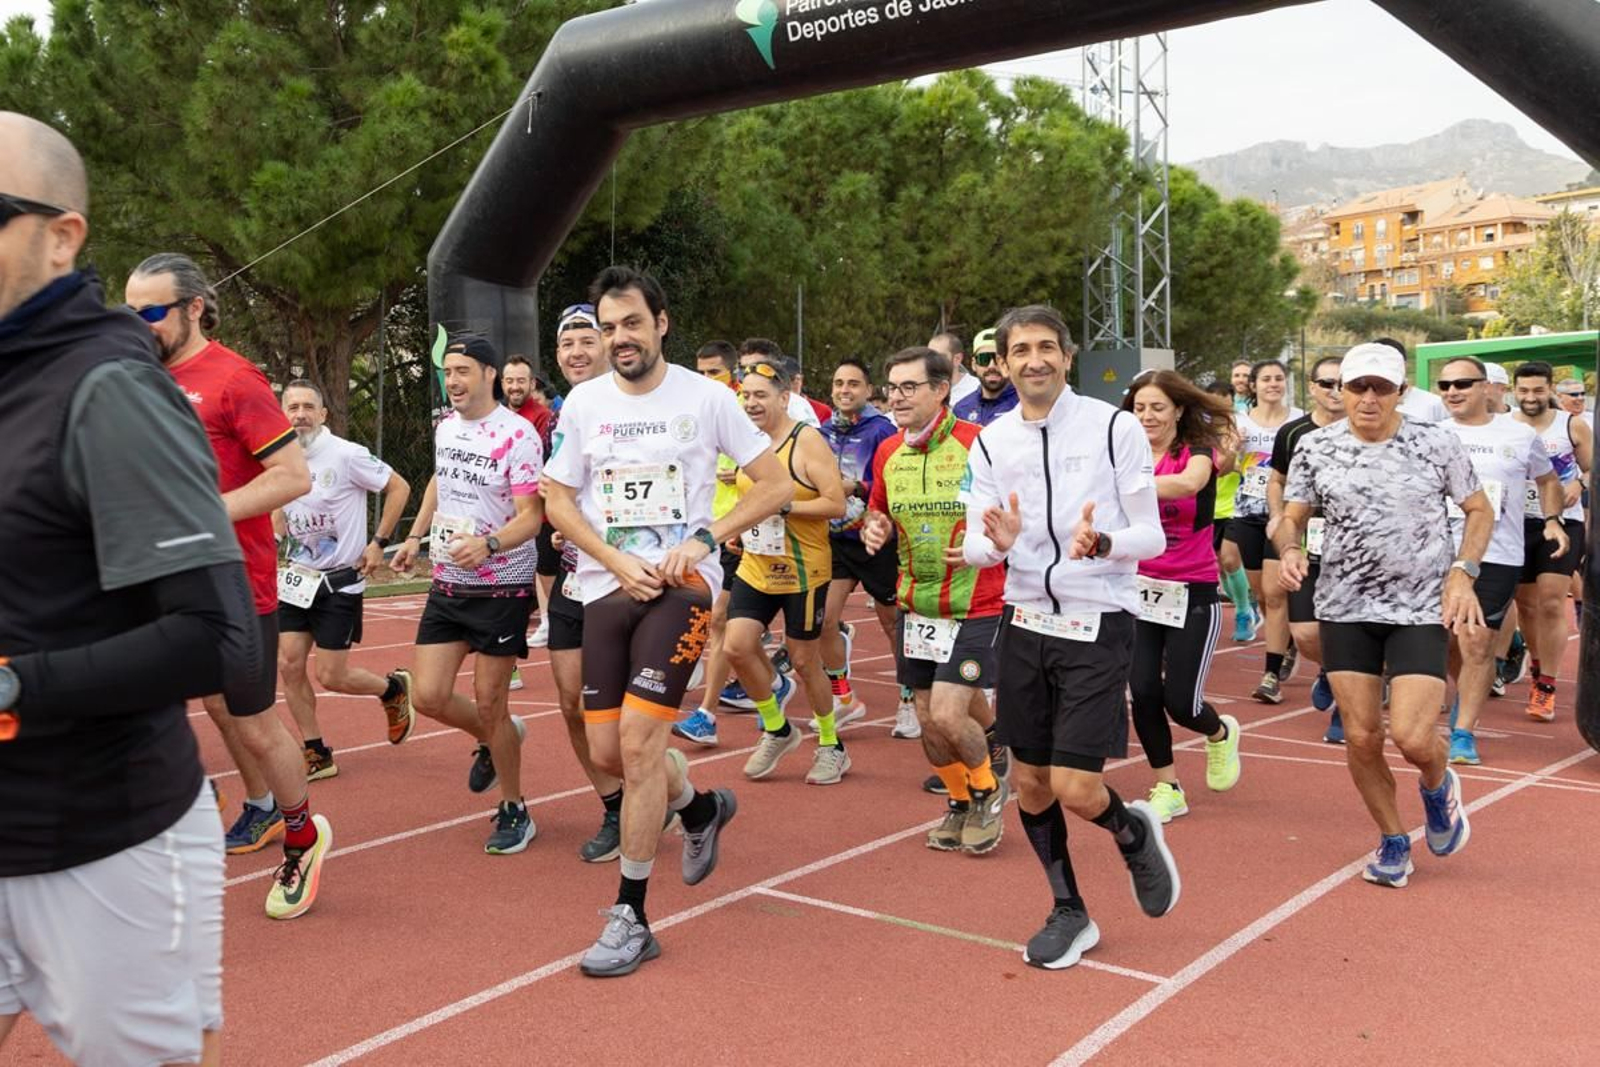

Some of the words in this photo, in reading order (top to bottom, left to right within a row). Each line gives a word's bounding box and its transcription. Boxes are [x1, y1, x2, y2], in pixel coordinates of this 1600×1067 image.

[787, 7, 880, 42] Deportes
[885, 0, 913, 19] de
[599, 423, 613, 434] 26
[613, 424, 667, 437] PUENTES
[450, 467, 460, 479] &
[462, 469, 490, 486] TRAIL
[624, 480, 653, 501] 57
[908, 501, 967, 512] HYUNDAI
[285, 572, 303, 587] 69
[1140, 589, 1164, 604] 17
[917, 623, 936, 641] 72
